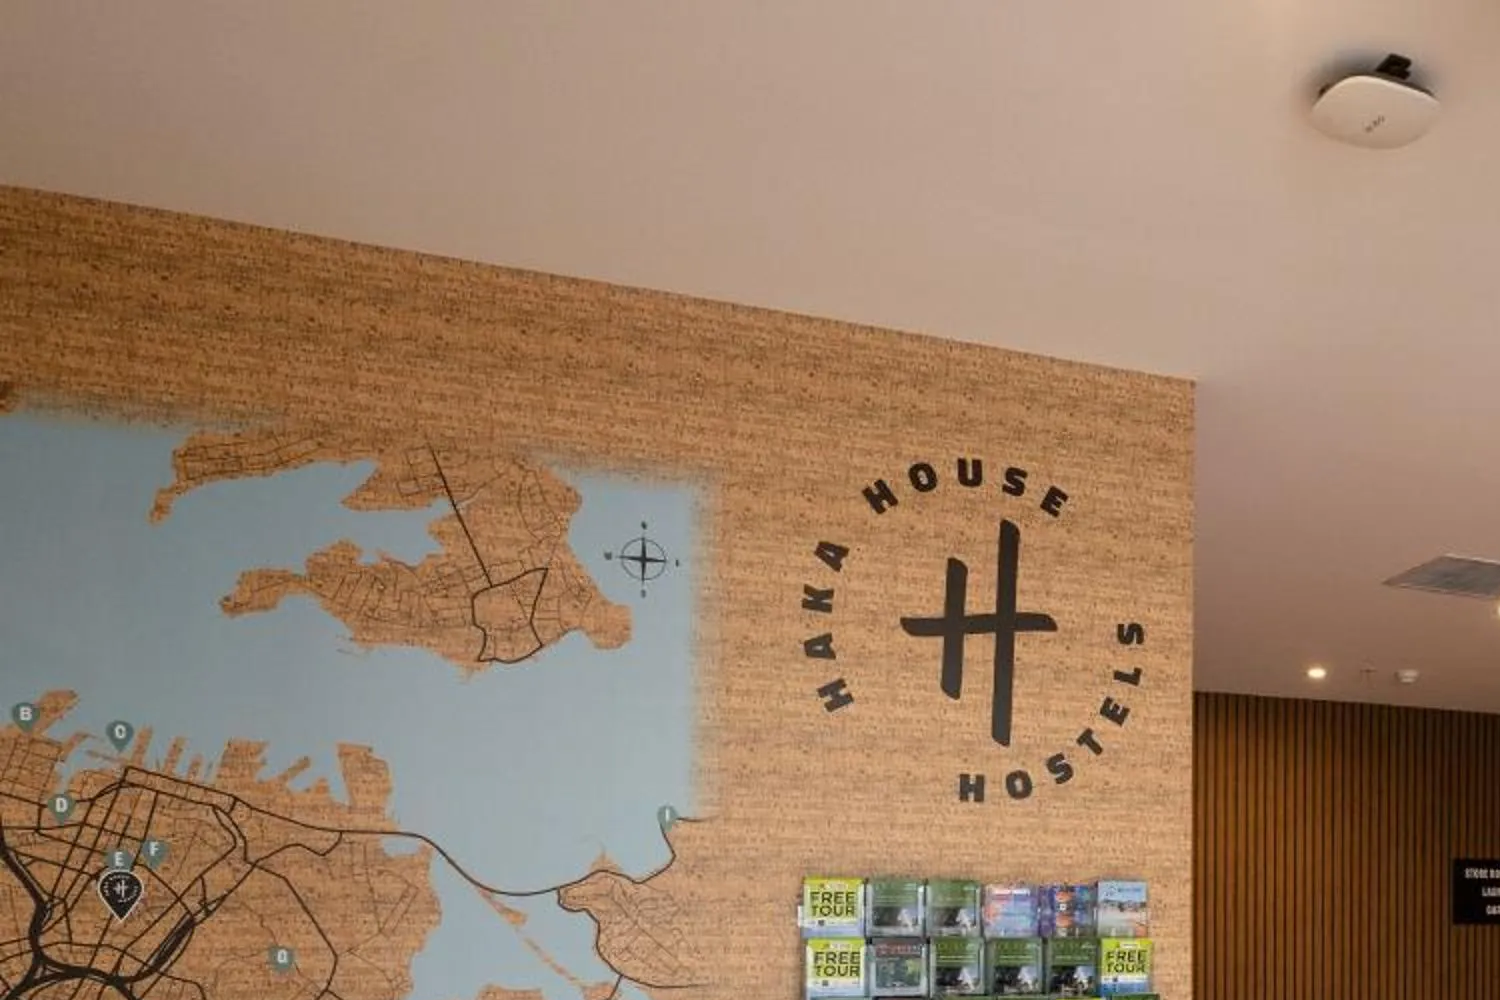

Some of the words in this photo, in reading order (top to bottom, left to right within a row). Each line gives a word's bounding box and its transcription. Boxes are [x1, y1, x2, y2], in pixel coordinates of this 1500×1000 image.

[801, 540, 854, 713] HAKA
[861, 458, 1069, 518] HOUSE
[19, 706, 33, 721] B
[958, 622, 1145, 803] HOSTELS
[55, 799, 68, 813] D
[150, 842, 160, 857] F
[114, 851, 124, 867] E
[809, 891, 856, 904] FREE
[811, 905, 855, 917] TOUR
[813, 951, 861, 965] FREE
[1105, 950, 1148, 962] FREE
[814, 965, 861, 977] TOUR
[1106, 962, 1146, 973] TOUR
